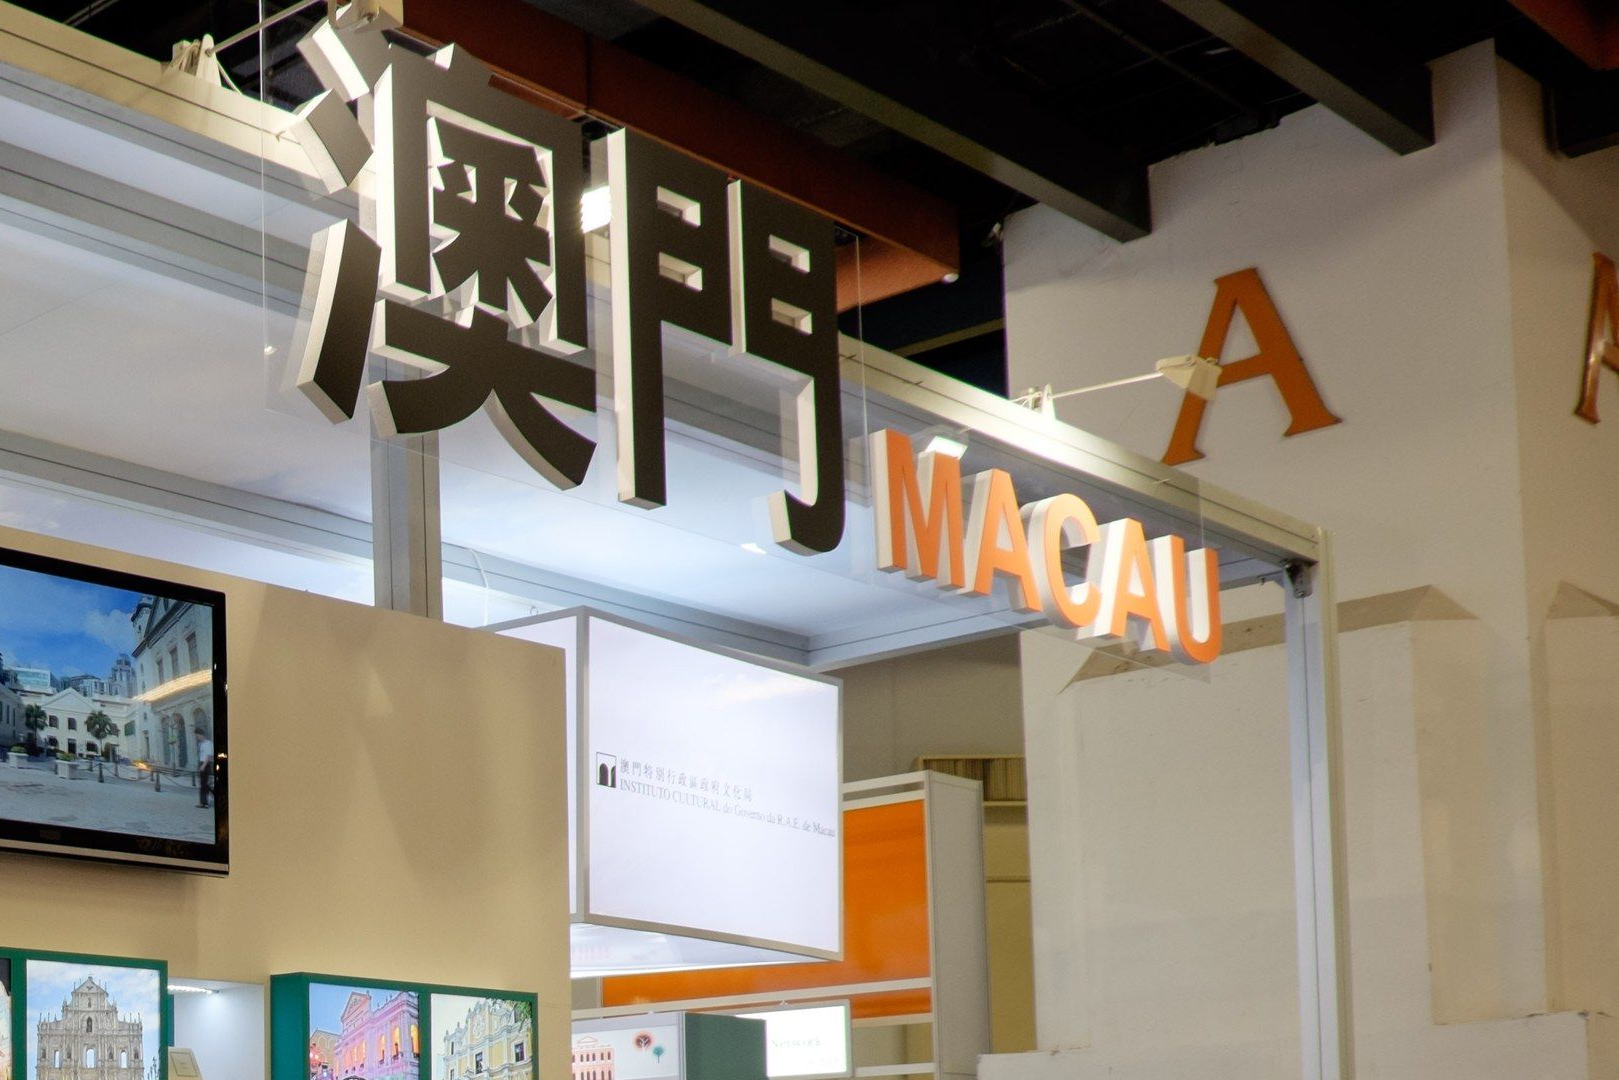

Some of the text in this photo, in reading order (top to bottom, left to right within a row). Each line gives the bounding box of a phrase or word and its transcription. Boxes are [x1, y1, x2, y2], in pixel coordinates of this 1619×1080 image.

[289, 8, 1222, 663] 澳門 MACAU
[1161, 267, 1343, 466] A
[620, 778, 671, 801] INSTITUTO
[672, 790, 721, 813] CULTURAL
